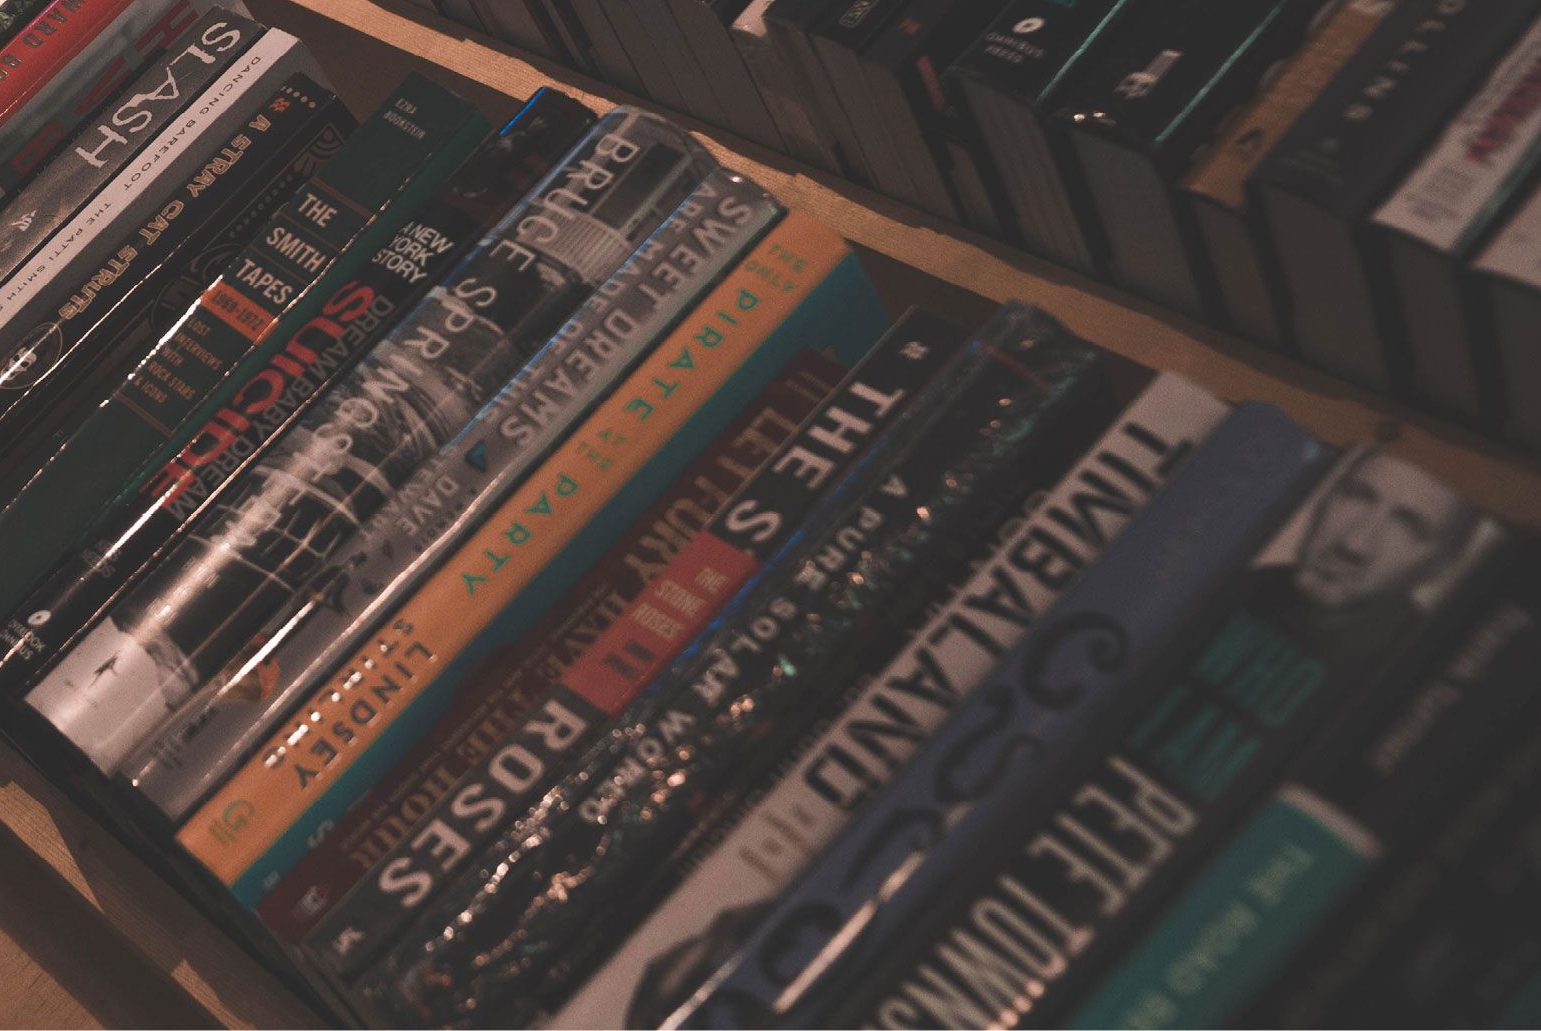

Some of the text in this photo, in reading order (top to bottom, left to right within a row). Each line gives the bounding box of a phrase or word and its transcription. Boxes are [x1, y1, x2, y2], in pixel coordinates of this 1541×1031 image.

[72, 14, 243, 172] SLASH
[198, 55, 261, 117] DANCING
[120, 117, 196, 192] BAREFOOT
[46, 226, 84, 261] PATTI
[56, 114, 271, 322] A STRAY CAT STRUTS
[84, 200, 112, 225] THE
[261, 222, 321, 281] SMITH
[292, 190, 336, 233] THE
[392, 225, 434, 266] YORK
[415, 218, 455, 257] NEW
[5, 264, 45, 301] SMITH
[234, 254, 291, 310] TAPES
[368, 238, 426, 295] STORY
[205, 128, 640, 561] BRUCE SPRINGSTEEN
[494, 192, 754, 447] SWEET DREAMS
[134, 275, 379, 511] SUICIDE
[162, 292, 396, 522] DREAM BABY DREAM
[451, 284, 761, 598] PIRATE PARTY
[767, 368, 907, 493] THE
[390, 473, 462, 538] DAVE
[796, 413, 1197, 811] TIMBALAND
[283, 638, 436, 790] LINDSEY
[370, 699, 590, 908] ROSES
[1023, 753, 1205, 912] PETE
